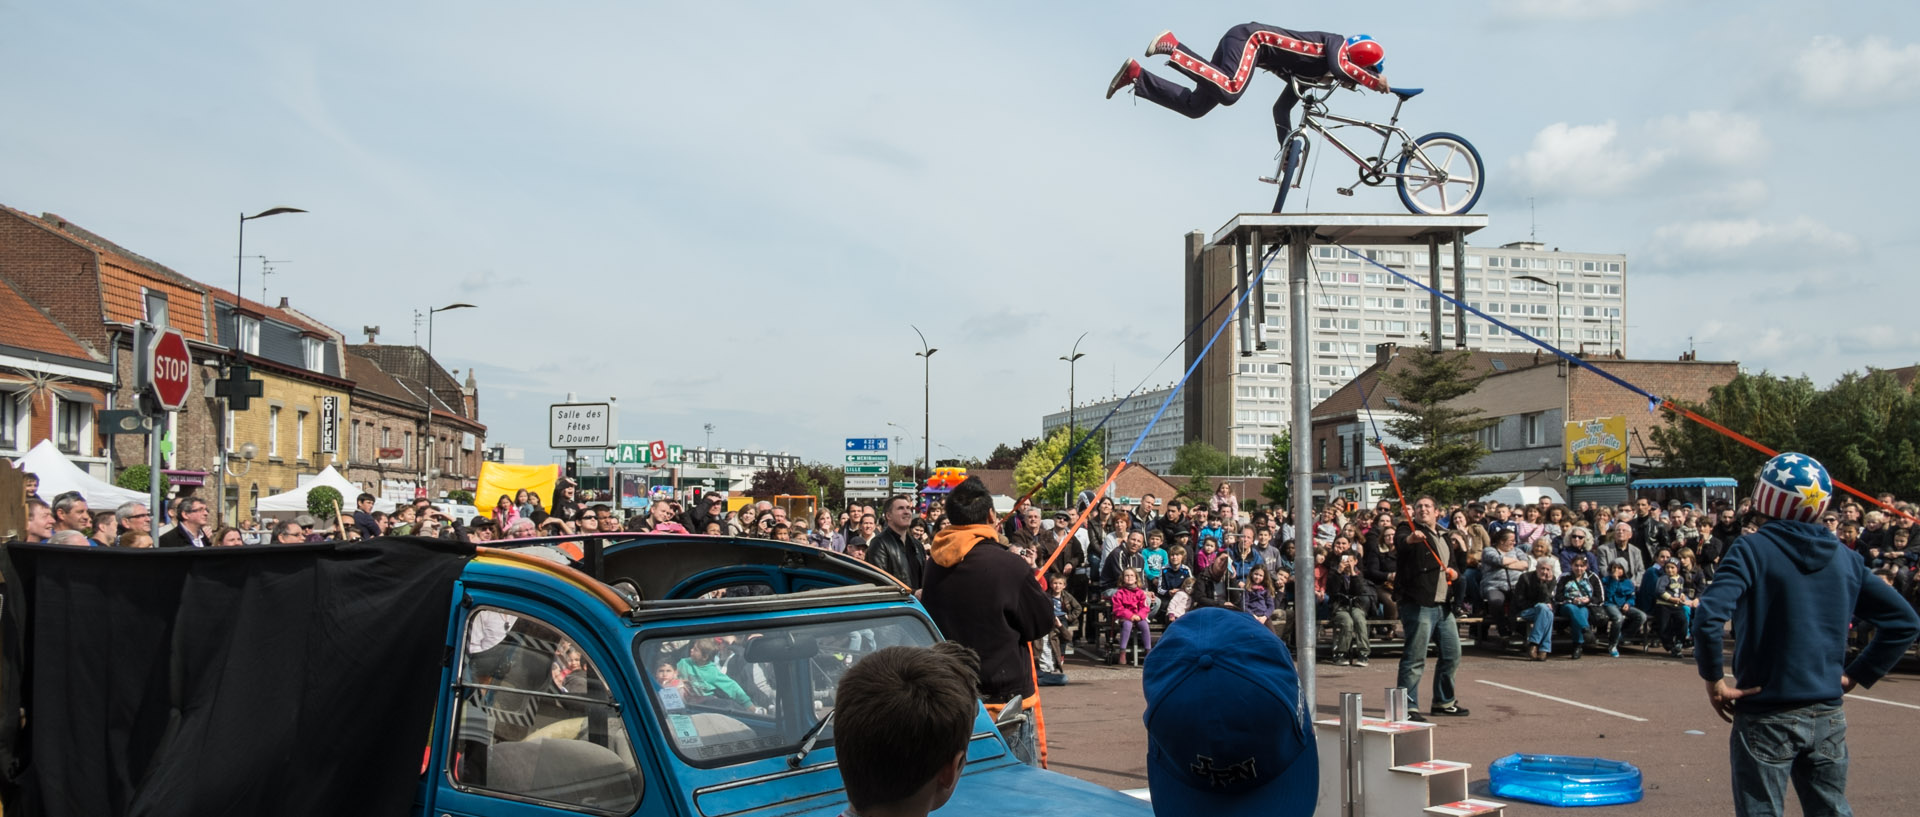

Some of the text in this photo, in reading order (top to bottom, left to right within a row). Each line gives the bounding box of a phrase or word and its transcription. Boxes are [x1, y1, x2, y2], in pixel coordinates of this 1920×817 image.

[156, 355, 188, 383] STOP
[324, 396, 334, 450] COIFFURE
[557, 410, 601, 419] Salle des
[567, 422, 591, 431] Fêtes
[1585, 423, 1604, 434] Super
[1588, 434, 1599, 445] des
[1599, 432, 1621, 450] Halles
[605, 442, 682, 462] MATCH
